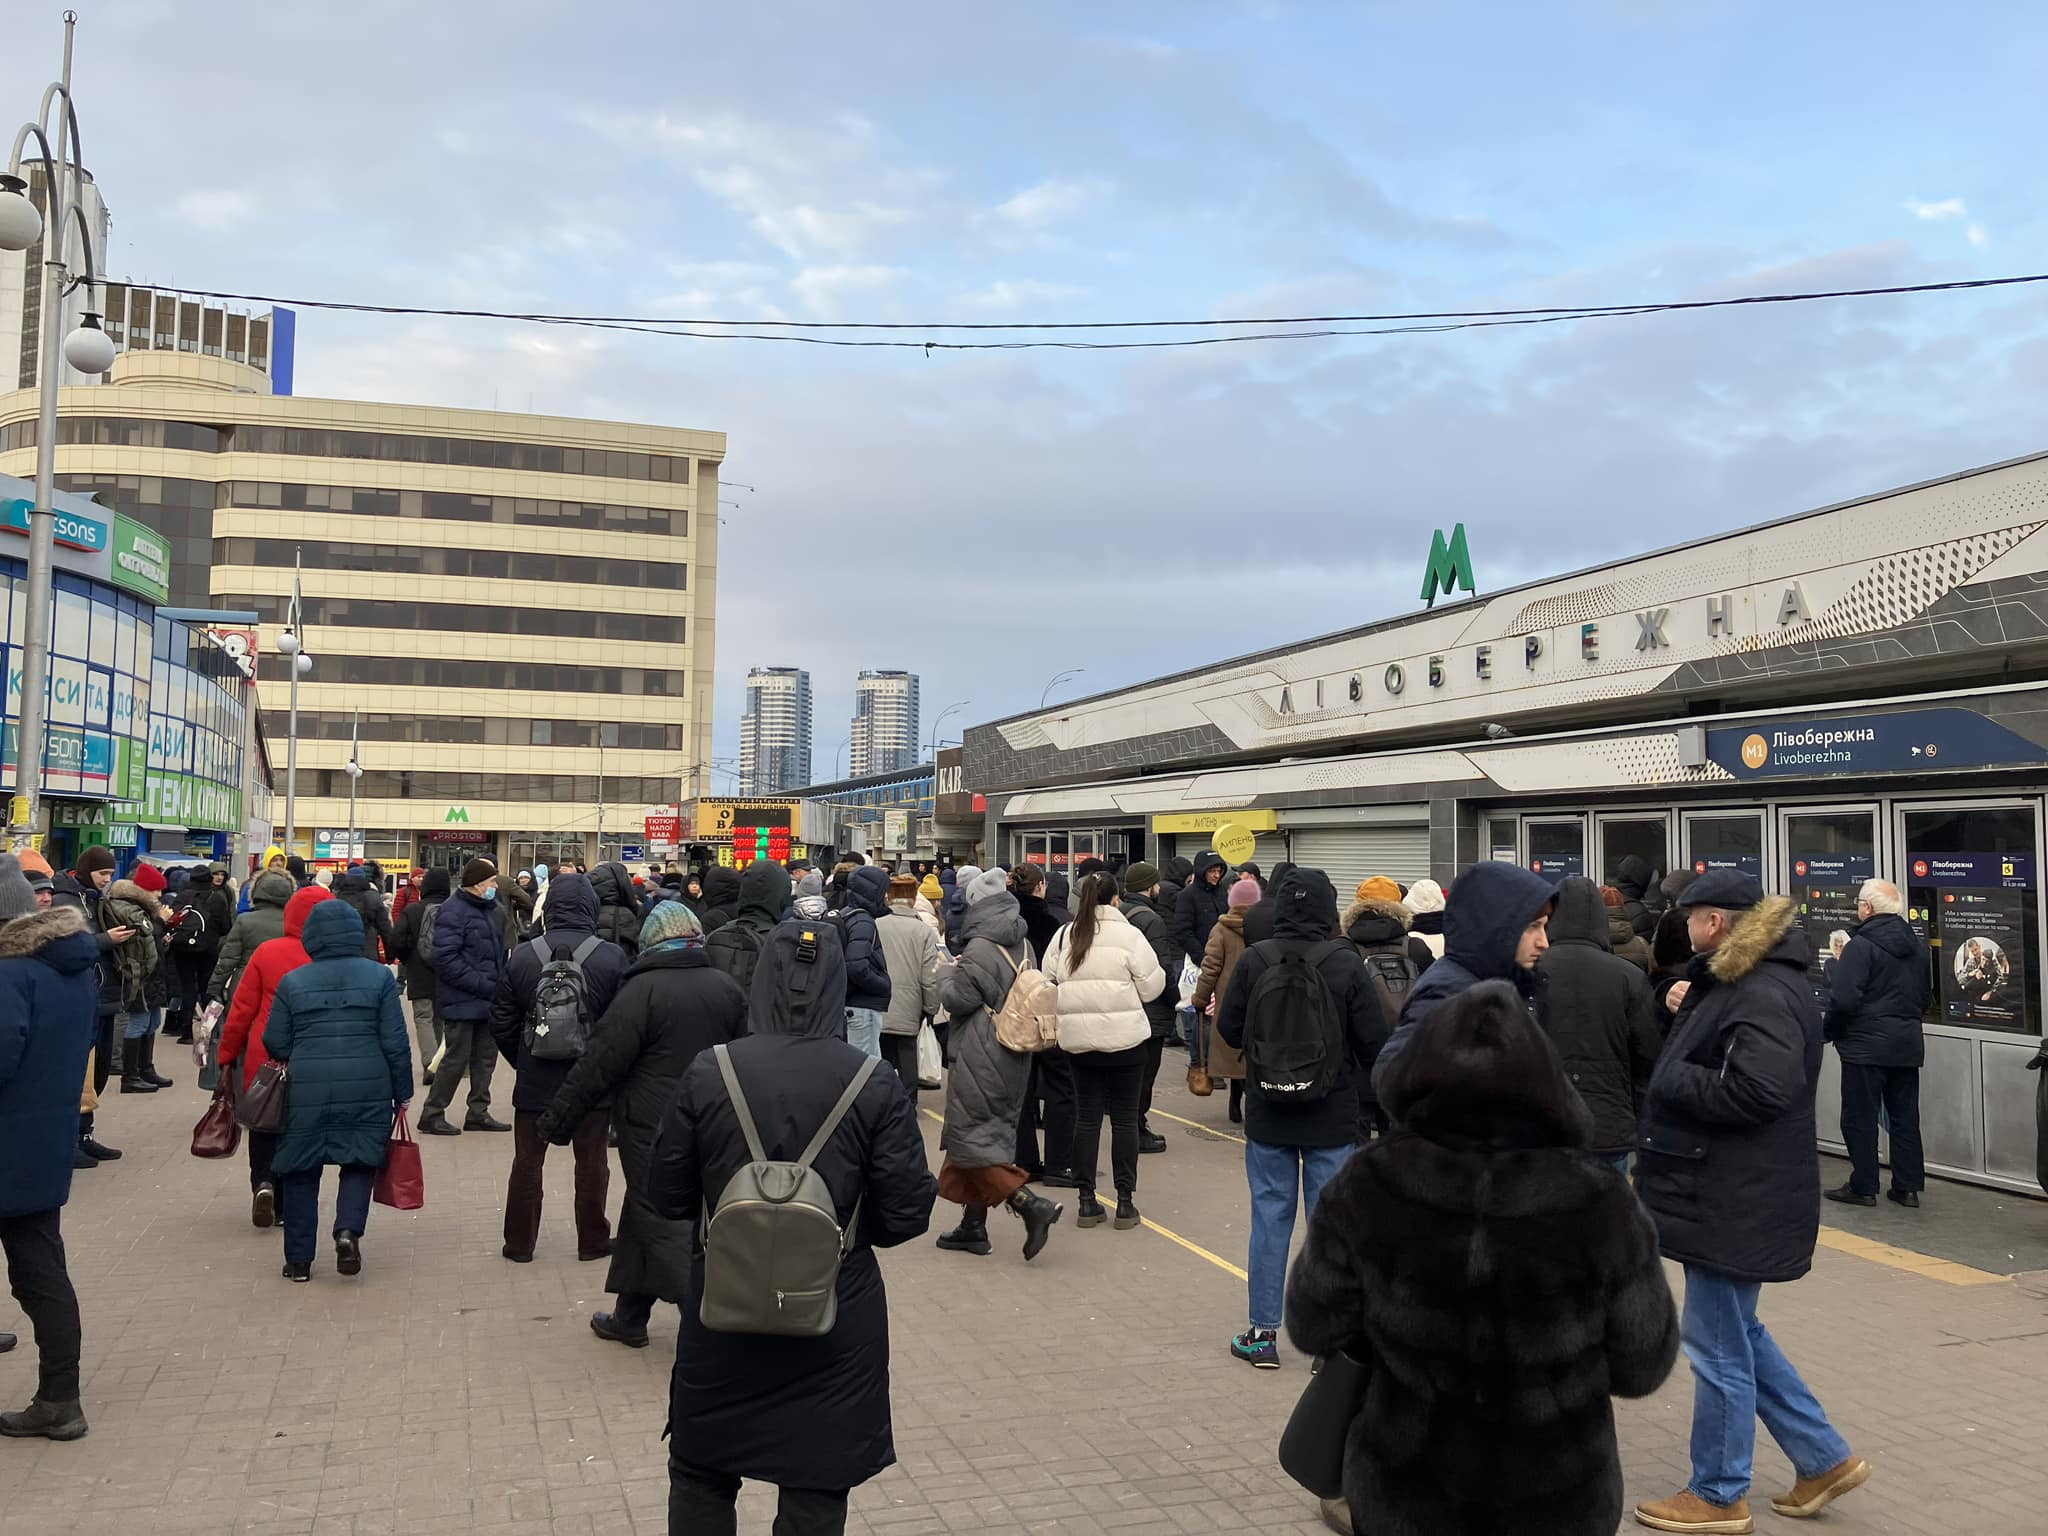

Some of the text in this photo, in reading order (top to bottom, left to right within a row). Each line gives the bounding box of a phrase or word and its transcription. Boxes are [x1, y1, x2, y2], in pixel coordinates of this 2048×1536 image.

[1772, 728, 1875, 749] Лівобережна
[1774, 748, 1851, 766] Livoberezhna
[939, 766, 972, 795] КАВ
[649, 824, 673, 832] НАПОЇ
